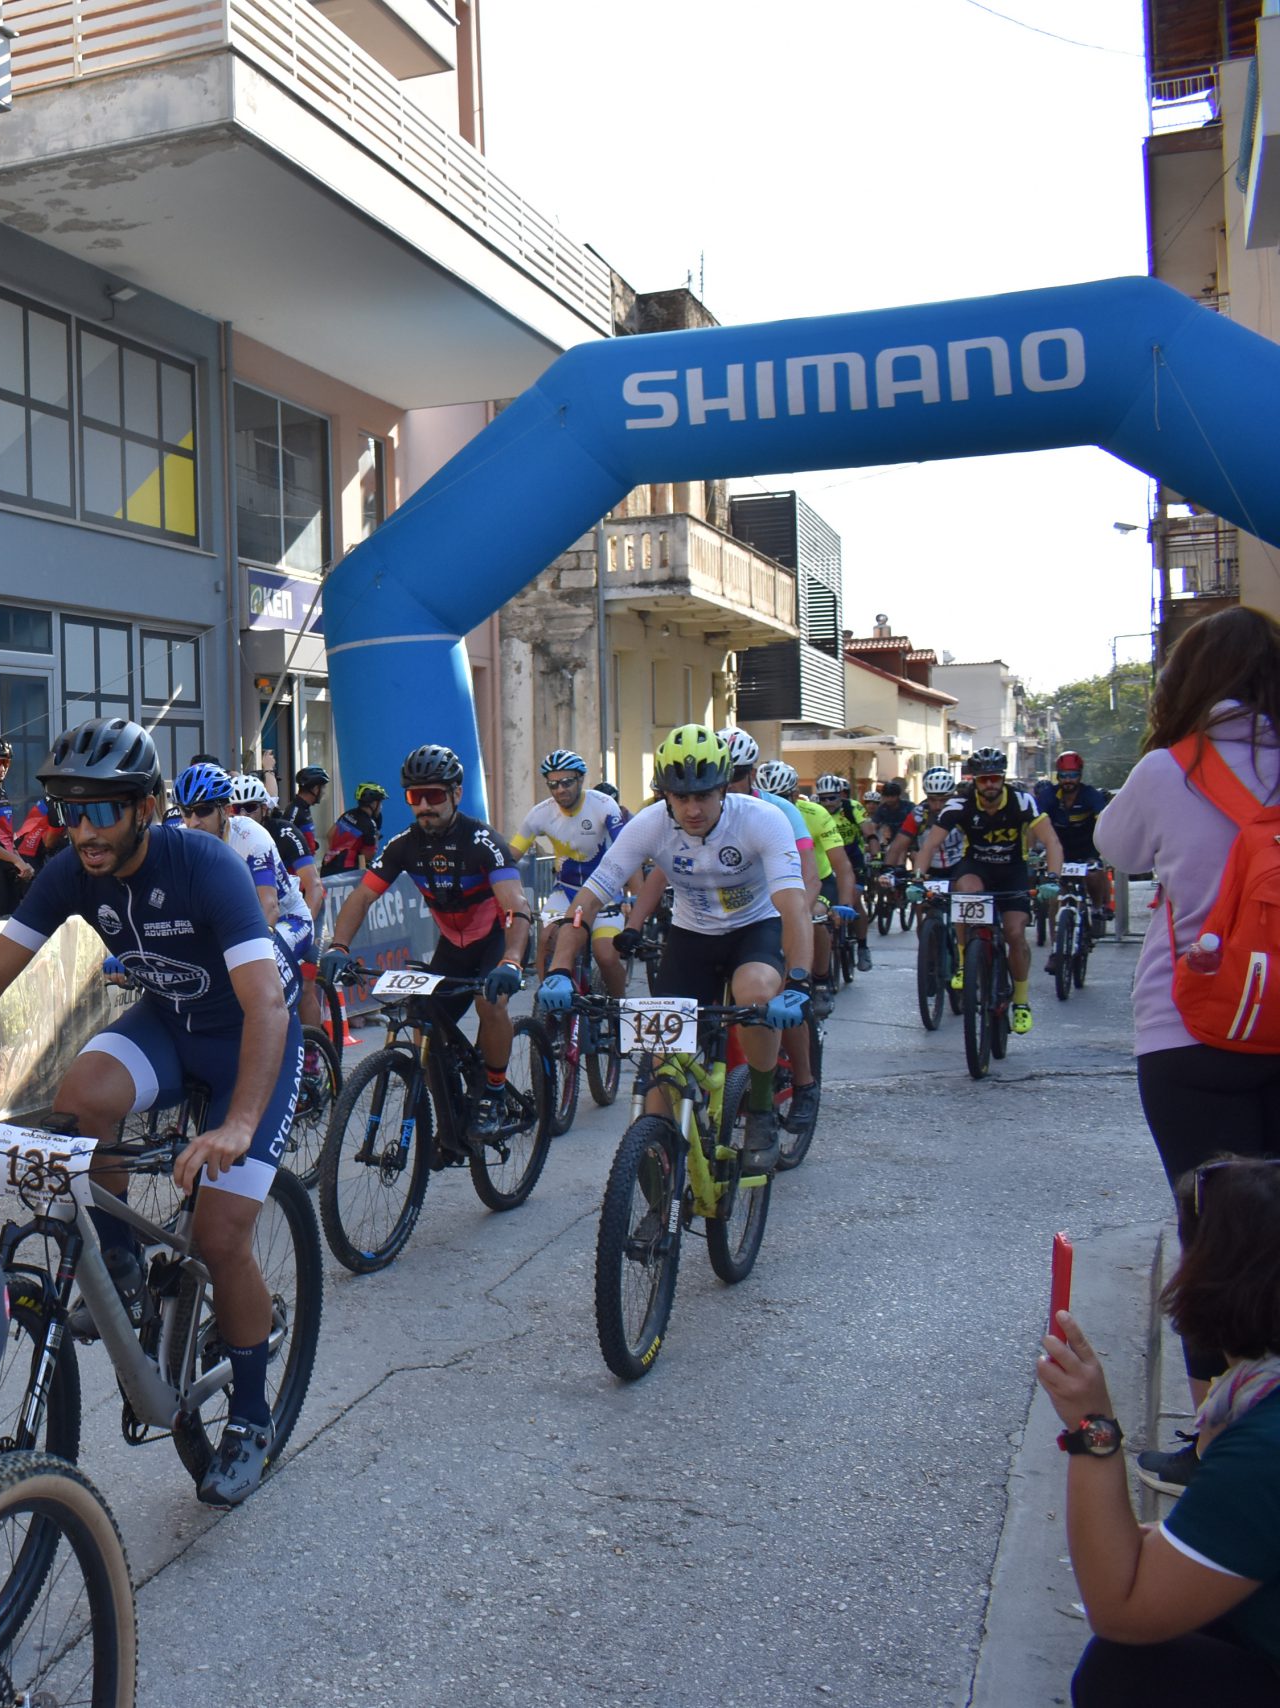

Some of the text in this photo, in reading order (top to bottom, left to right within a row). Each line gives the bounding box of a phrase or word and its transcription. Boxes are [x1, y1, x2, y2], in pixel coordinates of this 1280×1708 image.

[621, 327, 1086, 430] SHIMANO
[286, 829, 305, 855] CUBE
[481, 837, 505, 867] CUBE
[143, 921, 171, 930] GREEK
[959, 903, 985, 918] 103
[386, 975, 430, 990] 109
[634, 1012, 683, 1045] 149
[269, 1046, 305, 1158] CYCLELAND
[7, 1144, 72, 1195] 135
